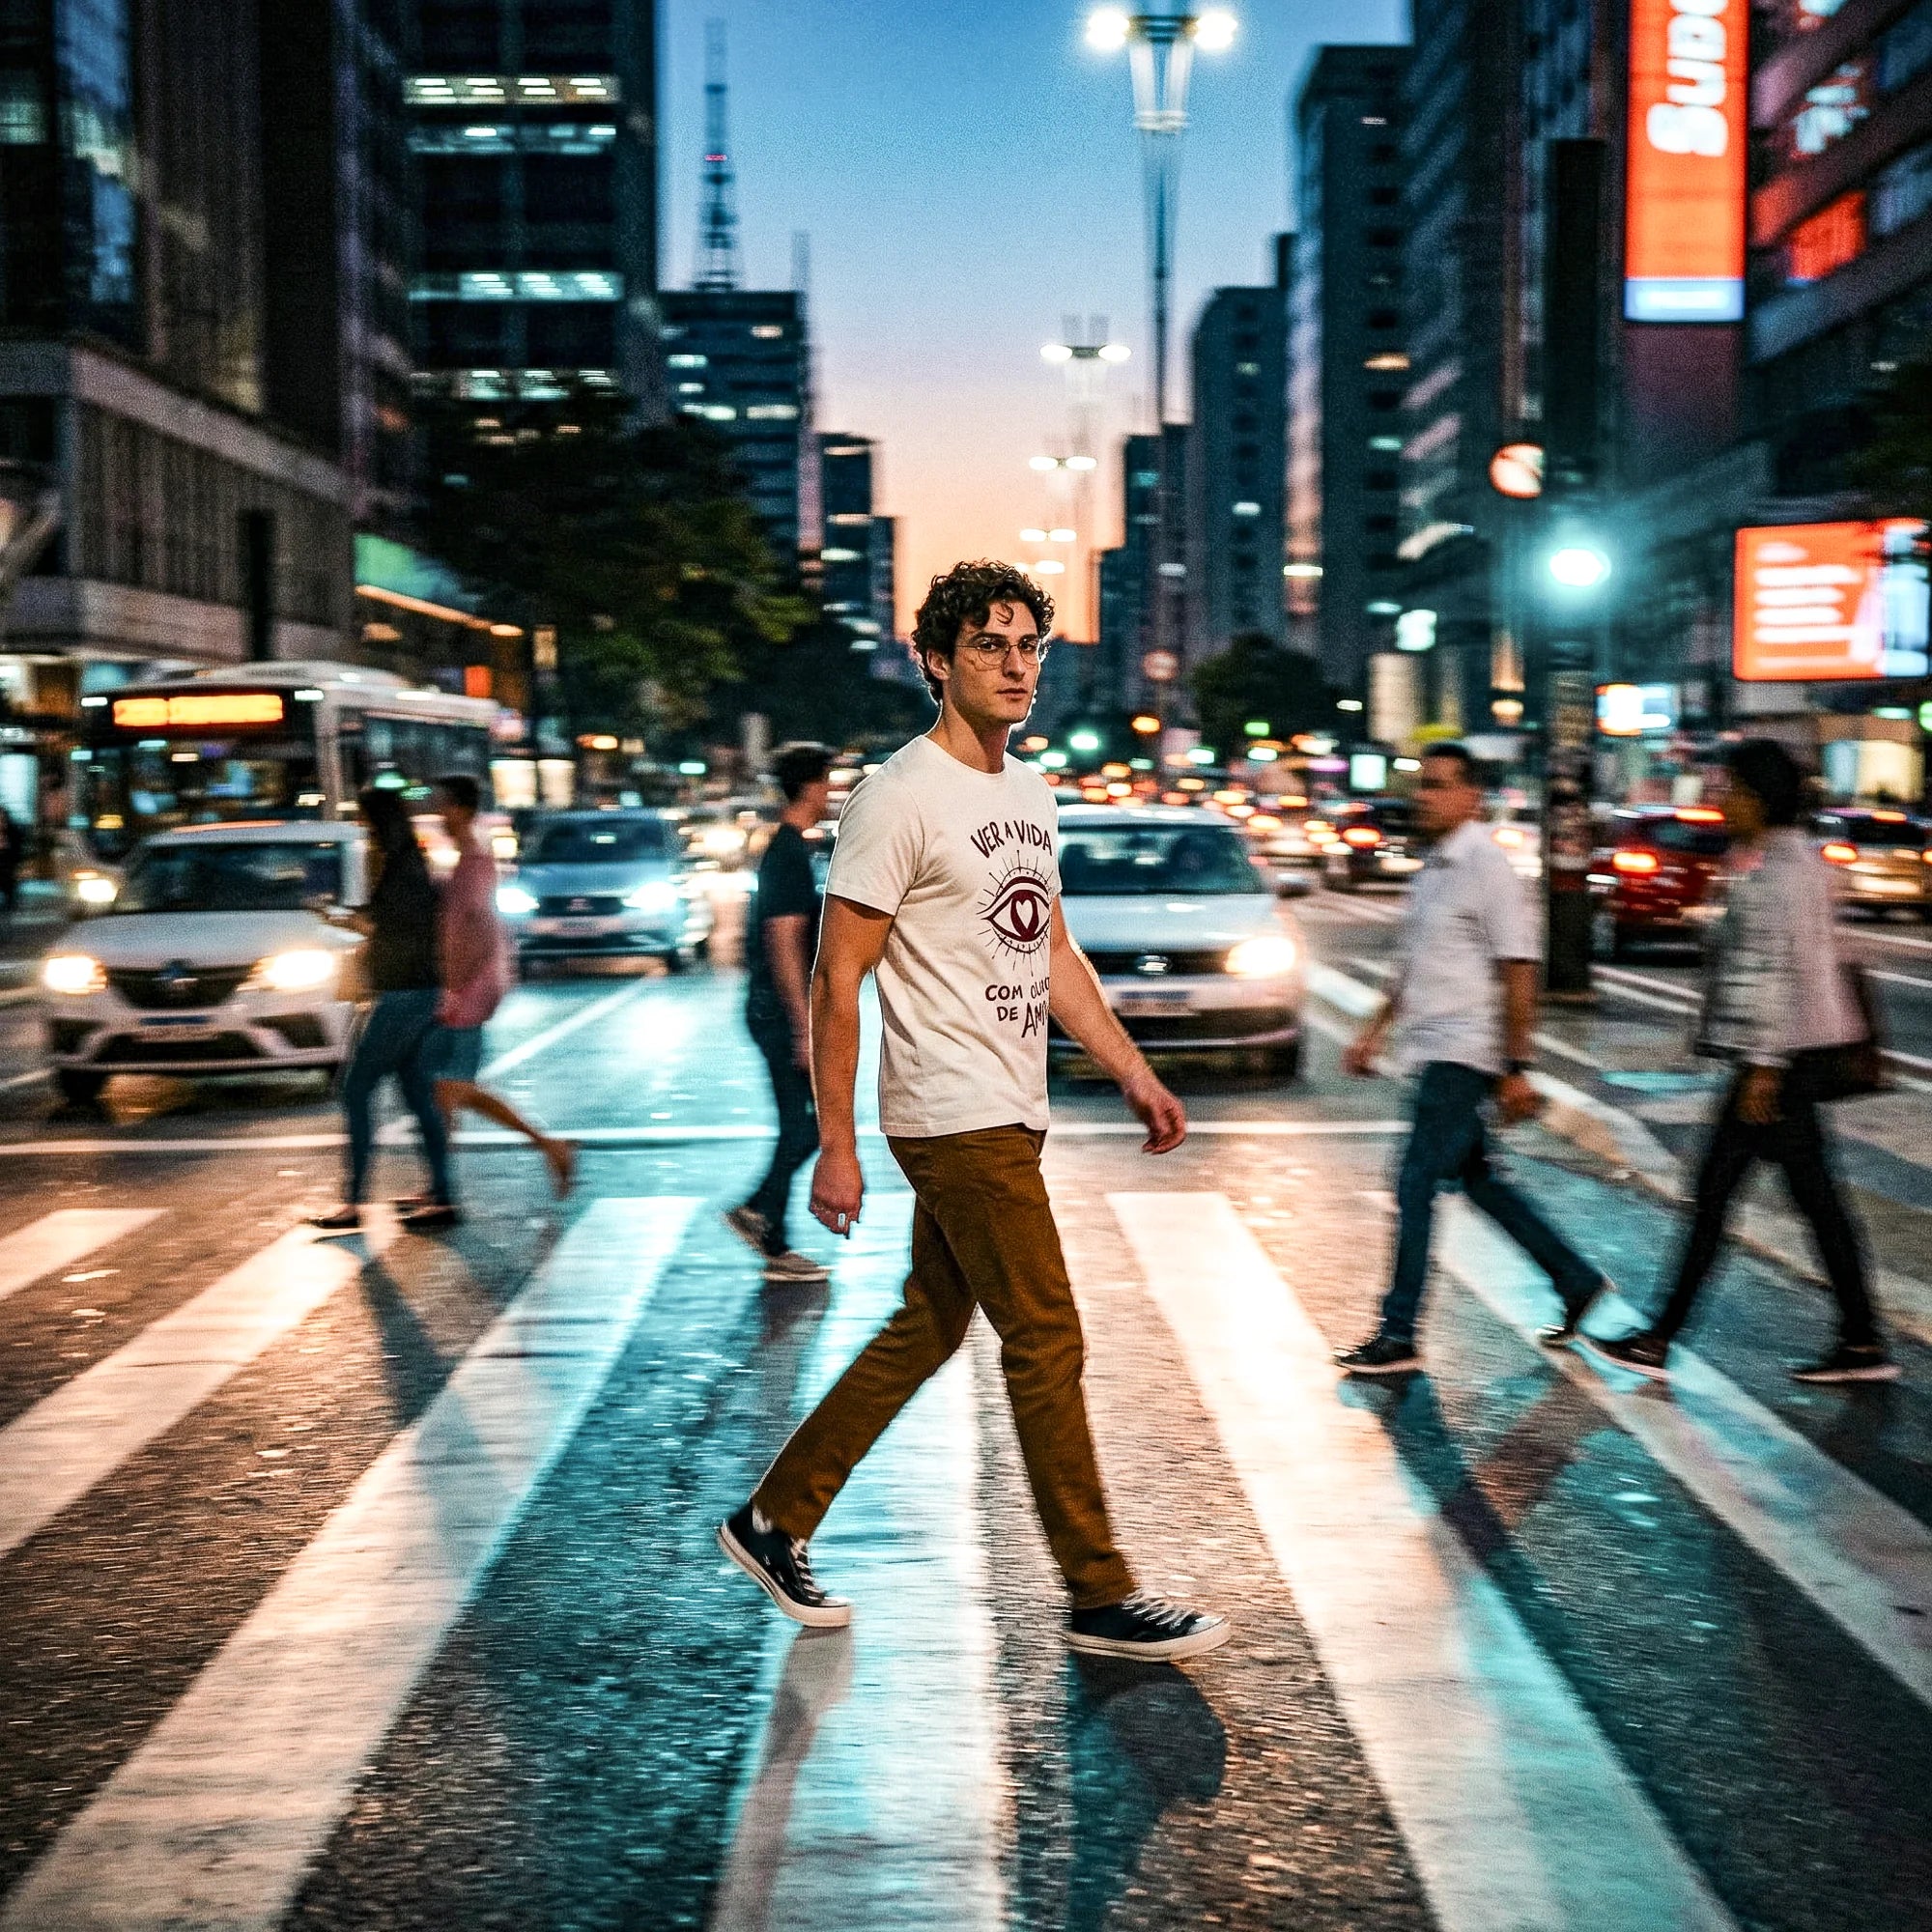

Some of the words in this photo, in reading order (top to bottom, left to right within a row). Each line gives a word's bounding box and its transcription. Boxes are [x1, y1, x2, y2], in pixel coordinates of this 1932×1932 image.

[970, 821, 1006, 859] VER
[1004, 821, 1014, 839] A
[1012, 819, 1053, 857] VIDA
[984, 983, 1024, 1002] COM
[996, 1006, 1019, 1021] DE
